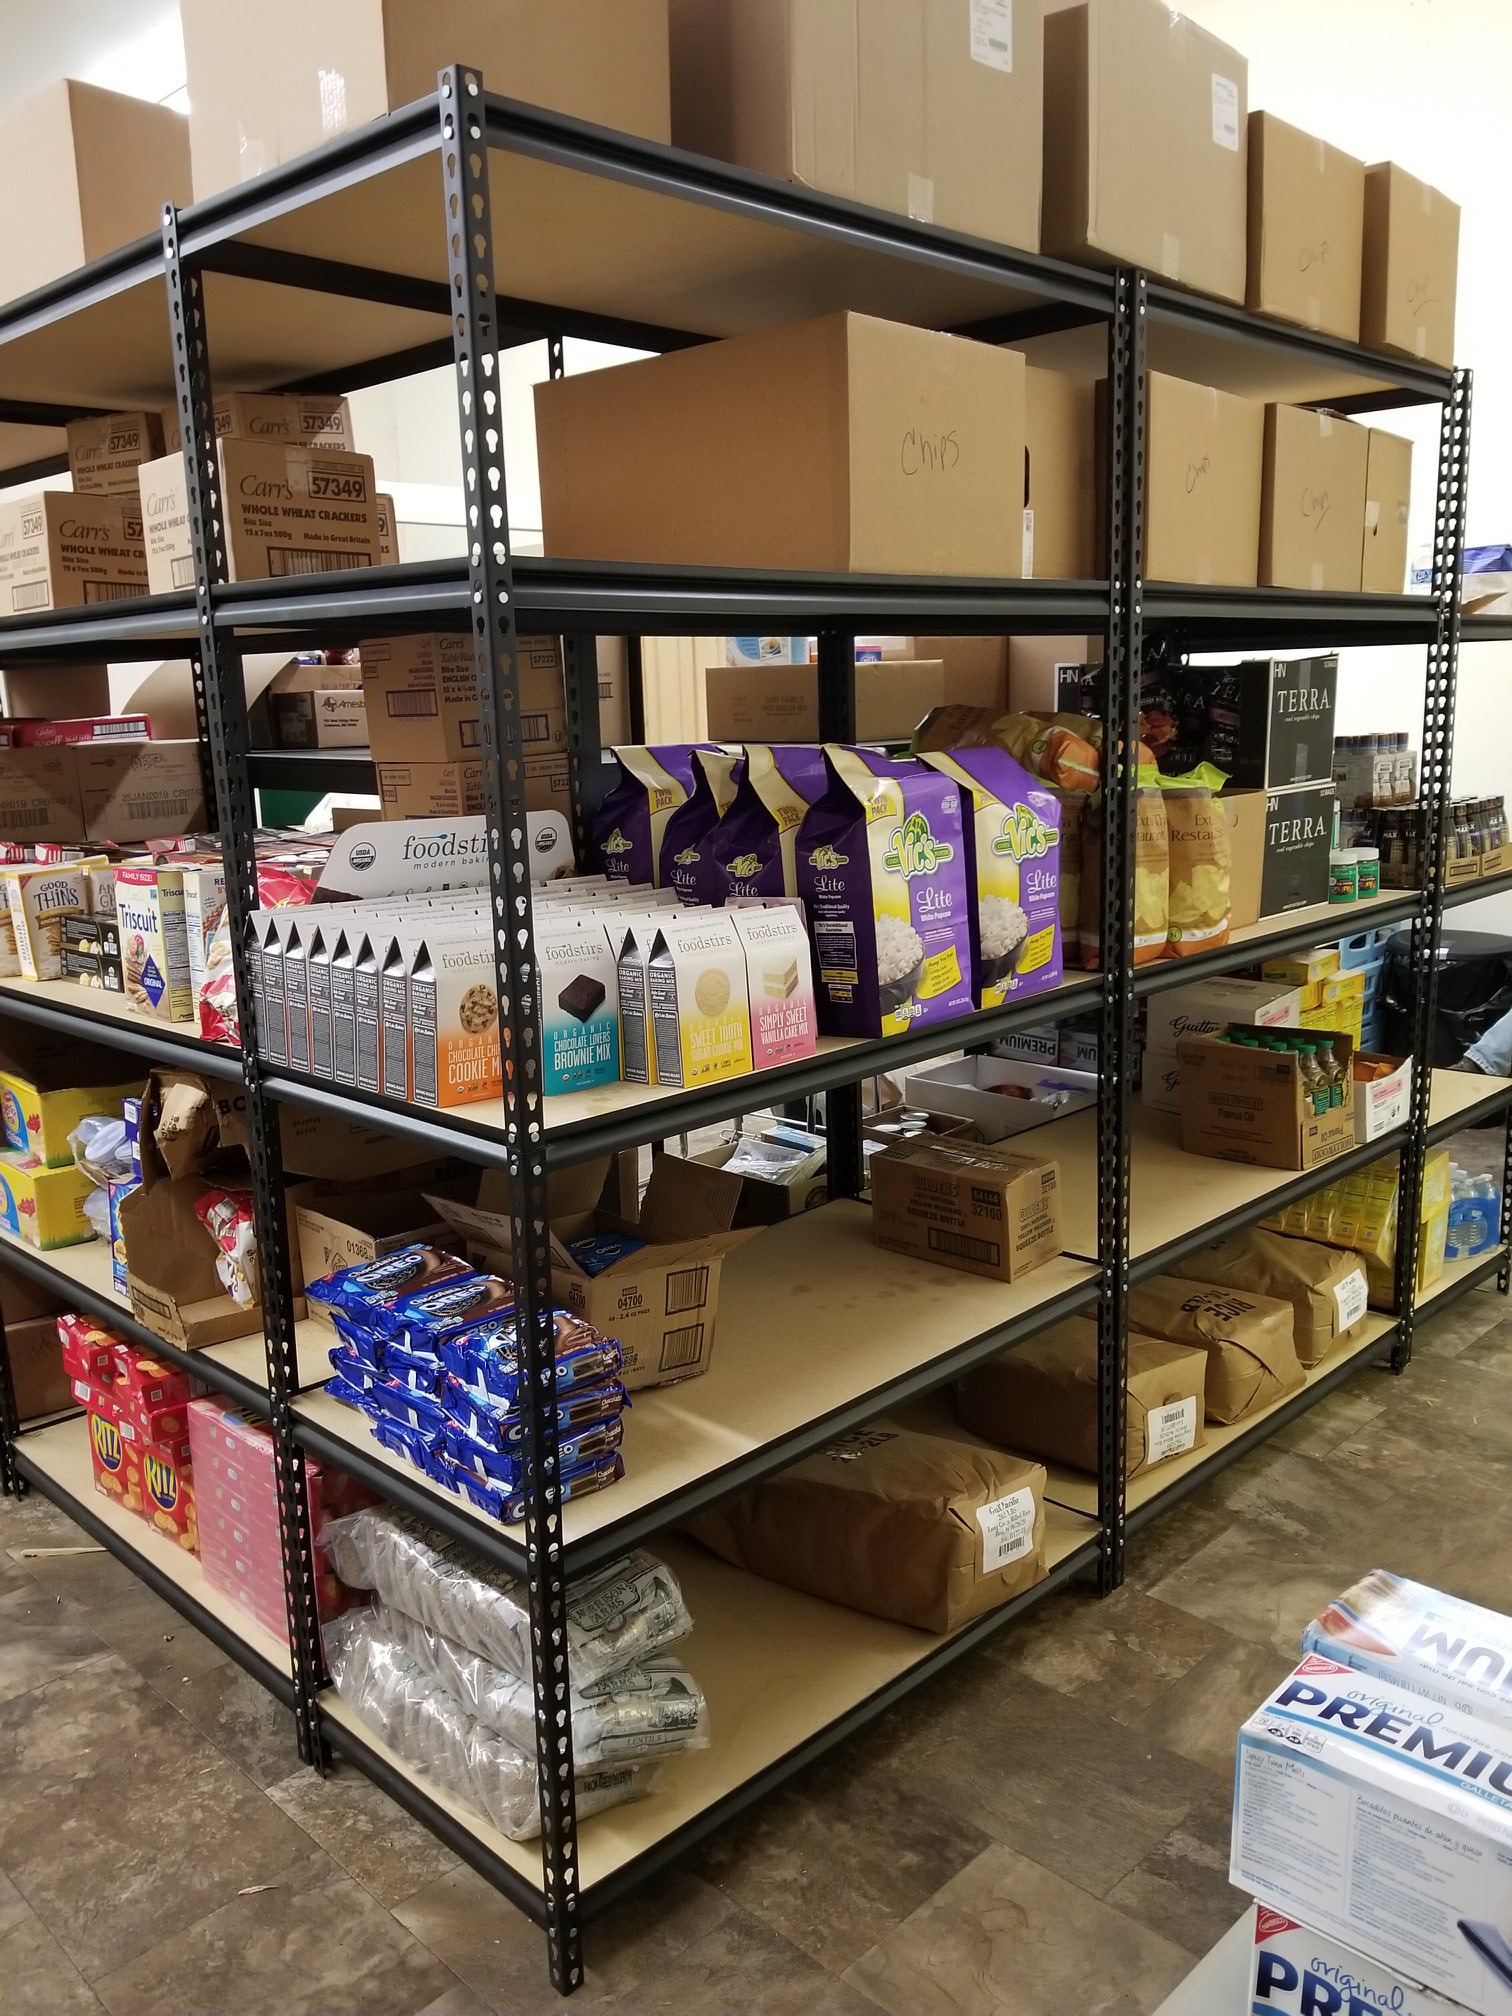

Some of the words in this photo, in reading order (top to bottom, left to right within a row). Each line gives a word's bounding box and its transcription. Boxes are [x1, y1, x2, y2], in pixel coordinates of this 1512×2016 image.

[250, 417, 292, 436] Carr's
[303, 414, 342, 431] 57349
[109, 431, 139, 451] 57349
[901, 427, 960, 475] Chips
[240, 475, 293, 500] Carr's
[311, 475, 364, 499] 57349
[241, 504, 279, 517] WHOLE
[281, 507, 317, 520] WHEAT
[319, 510, 368, 524] CRACKERS
[23, 515, 43, 535] 57349
[59, 519, 110, 541] Carr's
[150, 523, 168, 534] WHOLE
[304, 533, 320, 541] Made
[330, 535, 349, 543] Great
[350, 536, 371, 544] Britain
[61, 544, 96, 555] WHOLE
[98, 546, 130, 557] WHEAT
[442, 675, 470, 683] ENGLISH
[1060, 669, 1079, 683] HN
[1274, 663, 1287, 679] HN
[338, 699, 367, 708] Amesb
[1277, 688, 1333, 713] TERRA
[656, 797, 673, 808] PACK
[871, 803, 888, 815] PACK
[783, 813, 800, 825] PACK
[1269, 816, 1328, 845] TERRA
[1383, 831, 1398, 839] MAX
[1455, 824, 1469, 833] MAX
[1004, 817, 1047, 859] Vic's
[48, 850, 62, 864] LU
[356, 849, 371, 857] USDA
[891, 829, 937, 877] Vic's
[413, 860, 456, 870] modern
[606, 858, 630, 874] Lite
[122, 871, 139, 879] FAMILY
[671, 869, 697, 886] Lite
[814, 875, 846, 892] Lite
[1026, 869, 1057, 894] Lite
[40, 881, 68, 891] GOOD
[161, 889, 184, 898] Triscu
[729, 881, 759, 897] Lite
[917, 886, 952, 913] Lite
[118, 903, 158, 934] Triscuit
[920, 912, 934, 922] White
[747, 922, 798, 941] foodstirs
[545, 943, 604, 961] foodstirs
[677, 933, 733, 954] foodstirs
[442, 949, 496, 969] foodstir
[619, 970, 643, 978] ORGANIC
[383, 979, 406, 990] ORGANIC
[412, 985, 435, 995] ORGANIC
[760, 1010, 785, 1032] SIMPLY
[786, 1005, 808, 1025] SWEET
[553, 1022, 611, 1041] ORGANIC
[690, 1027, 716, 1049] SWEET
[719, 1021, 743, 1041] TOOTH
[761, 1029, 785, 1045] VANILLA
[784, 1025, 799, 1040] CAKE
[798, 1022, 809, 1036] MIX
[554, 1035, 587, 1053] CHOCOLATE
[589, 1031, 611, 1048] LOVERS
[1000, 1035, 1056, 1056] PREMIUM
[448, 1046, 486, 1063] CHOCOLATE
[554, 1045, 595, 1071] BROWNIE
[596, 1043, 611, 1061] MIX
[448, 1059, 489, 1084] COOKIE
[1218, 1109, 1243, 1120] Peanut
[1244, 1111, 1255, 1122] Oil
[907, 1207, 938, 1222] SQUEEZE
[939, 1215, 966, 1227] BOTTLE
[971, 1203, 1001, 1221] 32100
[1016, 1234, 1037, 1252] SQUEEZE
[1037, 1225, 1054, 1242] BOTTLE
[356, 1252, 425, 1282] OREO
[418, 1284, 488, 1312] OREO
[618, 1294, 643, 1310] 04700
[619, 1312, 630, 1321] 2.4
[1206, 1298, 1257, 1322] RICE
[91, 1413, 121, 1461] RITZ
[144, 1454, 177, 1499] RITZ
[1001, 1497, 1020, 1510] Pacific
[576, 1582, 627, 1620] MORRISON
[590, 1599, 626, 1626] FARMS
[1304, 1664, 1336, 1673] NABISCO
[1419, 1663, 1439, 1674] mar
[1441, 1672, 1456, 1682] de
[595, 1677, 637, 1693] FARMS
[1456, 1679, 1474, 1689] sal
[1476, 1687, 1497, 1699] con
[1346, 1689, 1444, 1727] original
[627, 1734, 662, 1746] LENTILS
[1441, 1726, 1491, 1749] rociadas
[1246, 1748, 1265, 1764] Spicy
[1266, 1755, 1283, 1769] Tuna
[1285, 1761, 1306, 1778] Melts
[1356, 1795, 1392, 1818] Bocaditos
[1393, 1812, 1422, 1832] picantes
[1424, 1825, 1434, 1836] de
[1454, 1841, 1461, 1851] y
[1462, 1843, 1484, 1859] queso
[1262, 1917, 1287, 1930] NABISCO
[1311, 1957, 1404, 2016] original
